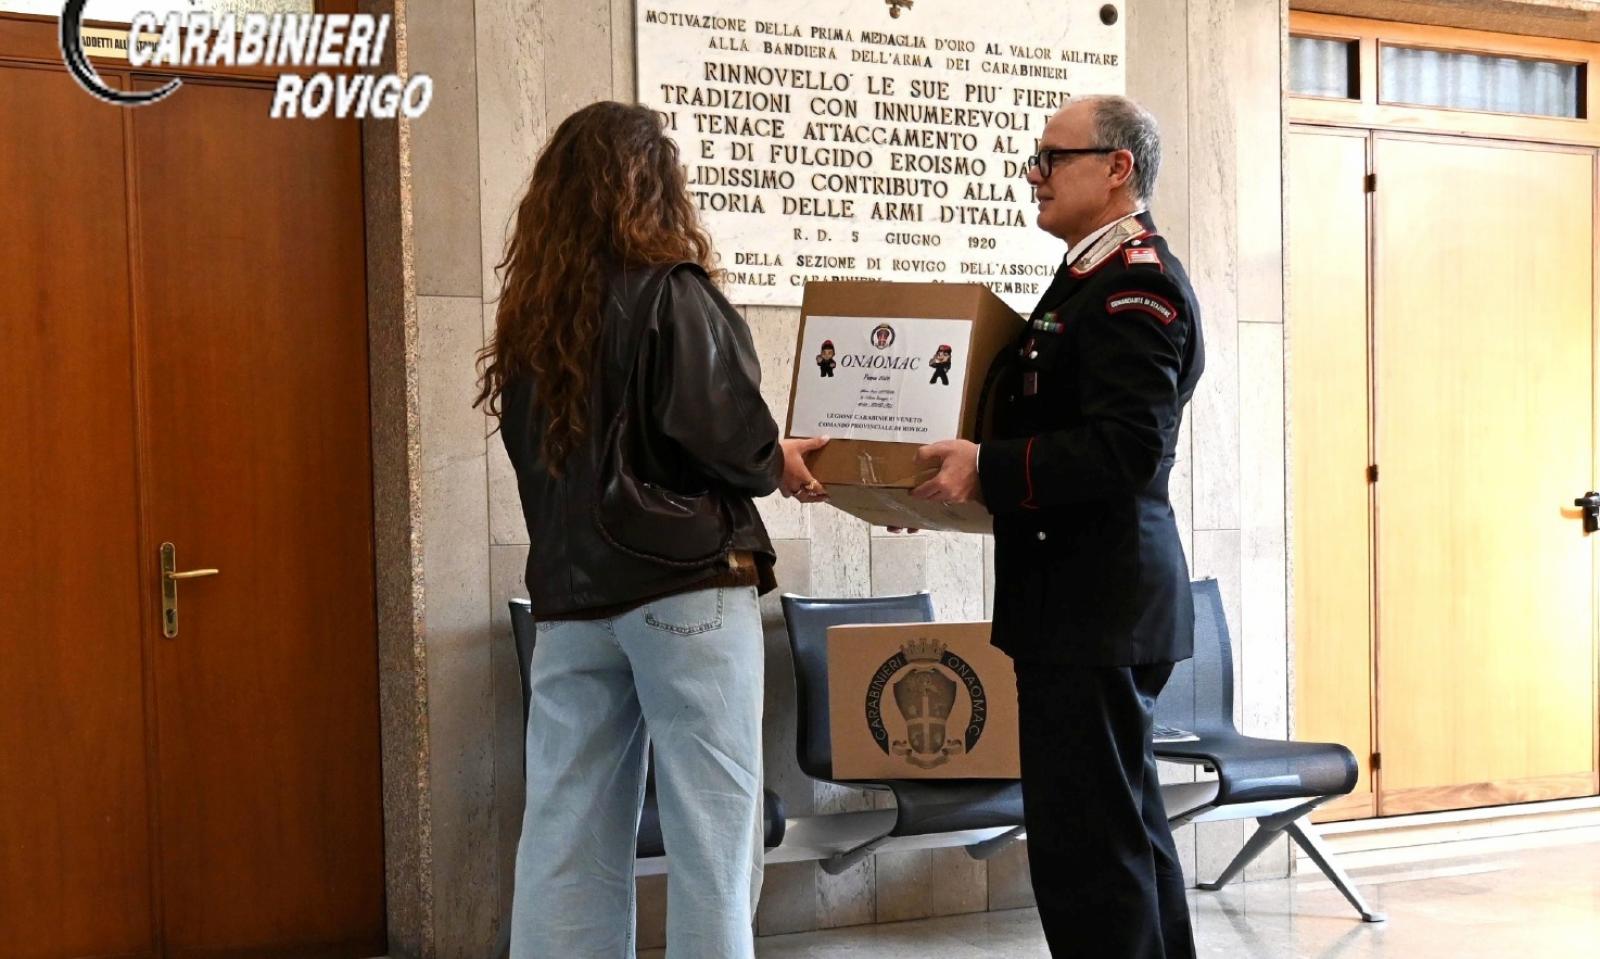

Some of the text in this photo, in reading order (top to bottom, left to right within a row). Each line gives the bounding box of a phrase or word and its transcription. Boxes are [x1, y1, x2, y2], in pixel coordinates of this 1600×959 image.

[646, 10, 1119, 67] MOTIVAZIONE DELLA PRIMA MEDAGLIA D'ORO AL VALOR MILITARE
[708, 36, 1068, 80] ALLA BANDIERA DELL'ARMA DEI CARABINIERI
[867, 75, 895, 96] LE
[910, 79, 950, 101] SUE
[660, 84, 1030, 131] TRADIZIONI CON INNUMEREVOLI
[694, 113, 785, 139] TENACE
[803, 122, 977, 152] ATTACCAMENTO
[993, 135, 1019, 154] AL
[701, 139, 715, 159] E
[731, 141, 754, 162] DI
[770, 144, 873, 169] FULGIDO
[891, 154, 987, 177] EROISMO
[811, 173, 948, 199] CONTRIBUTO
[964, 181, 1017, 203] ALLA
[691, 190, 1027, 228] TORIA DELLE ARMI D'ITALIA
[793, 228, 997, 250] R. D. 5 GIUGNO 1920
[735, 252, 783, 267] DELLA
[796, 254, 856, 269] SEZIONE
[867, 257, 881, 270] DI
[893, 259, 946, 272] ROVIGO
[968, 281, 1040, 295] VEMBRE
[840, 354, 921, 371] ONAOMAC
[826, 412, 923, 424] LEGIONE CARABINIERI VENETO
[850, 422, 892, 431] PROVINCIALE
[868, 656, 903, 741] CARABINIERI
[947, 656, 985, 737] ONAOMAC
